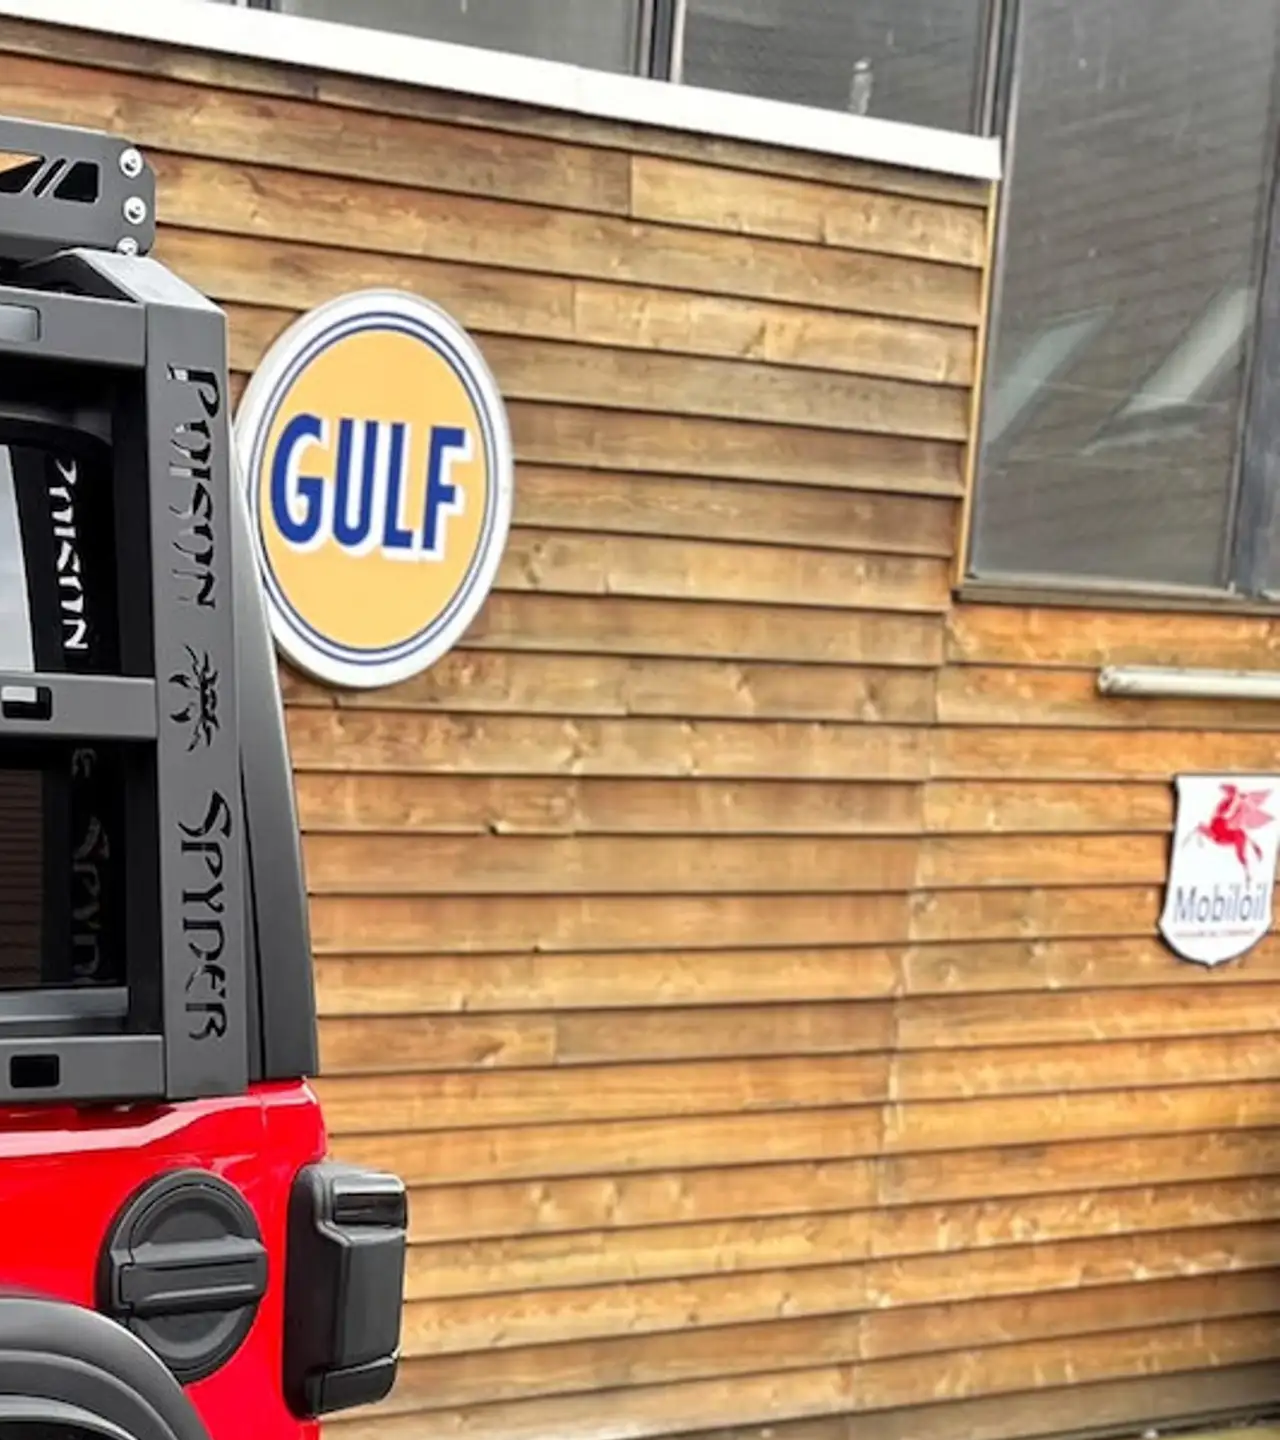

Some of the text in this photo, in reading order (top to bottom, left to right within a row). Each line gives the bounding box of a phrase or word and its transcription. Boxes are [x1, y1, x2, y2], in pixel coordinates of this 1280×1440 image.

[270, 412, 470, 555] GULF
[166, 362, 233, 1041] POISON SPYDER
[1172, 882, 1268, 923] Mobiloil
